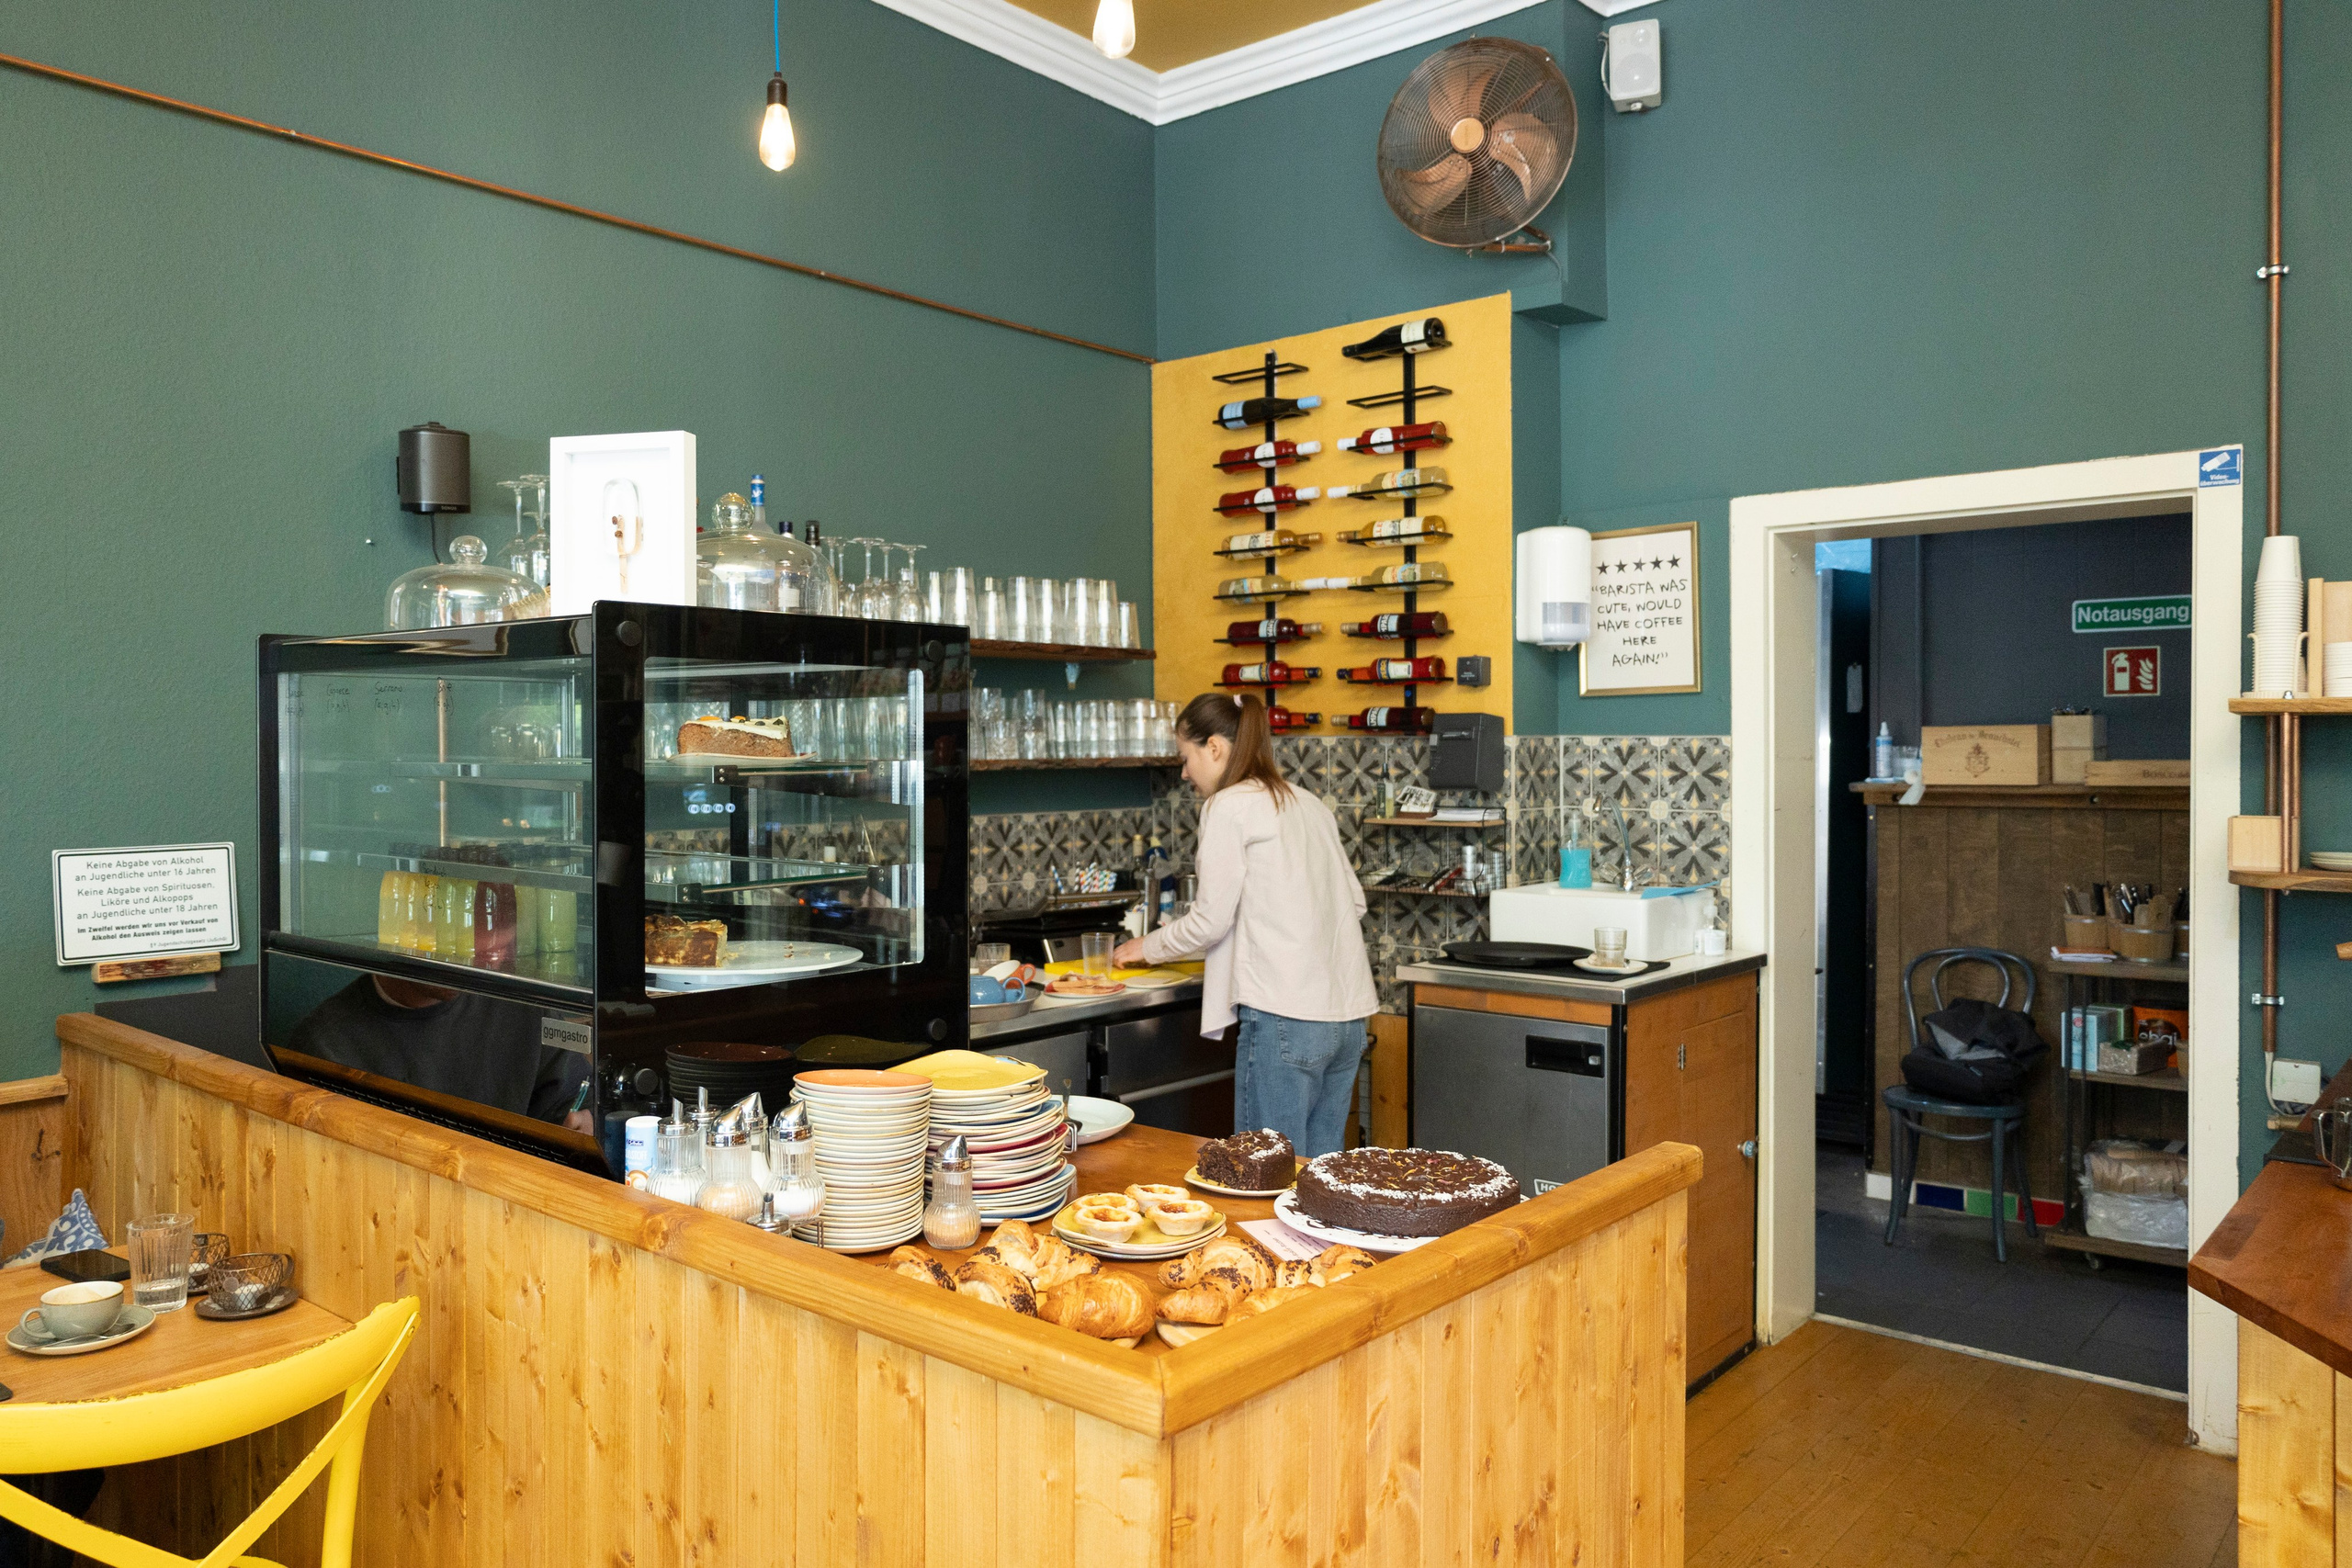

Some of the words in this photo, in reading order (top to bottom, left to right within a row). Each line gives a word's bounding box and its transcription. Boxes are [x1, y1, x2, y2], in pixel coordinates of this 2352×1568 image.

[1660, 579, 1688, 592] WAS
[1597, 602, 1630, 614] CUTE,
[1636, 599, 1681, 612] WOULD
[2077, 605, 2189, 624] Notausgang
[1597, 620, 1629, 632] HAVE
[1635, 617, 1683, 629] COFFEE
[1623, 636, 1657, 646] HERE
[87, 861, 112, 869] Keine
[116, 859, 150, 869] Abgabe
[171, 856, 204, 865] Alkohol
[89, 870, 144, 882] Jugendliche
[186, 866, 216, 875] Jahren
[78, 888, 104, 897] Keine
[107, 886, 141, 896] Abgabe
[101, 897, 130, 907] Liköre
[133, 895, 150, 904] und
[153, 894, 193, 904] Alkopops
[91, 908, 146, 920] Jugendliche
[149, 906, 173, 915] unter
[188, 903, 218, 912] Jahren
[92, 933, 117, 941] Alkohol
[163, 928, 183, 936] zeigen
[543, 1026, 588, 1044] ggmgastro
